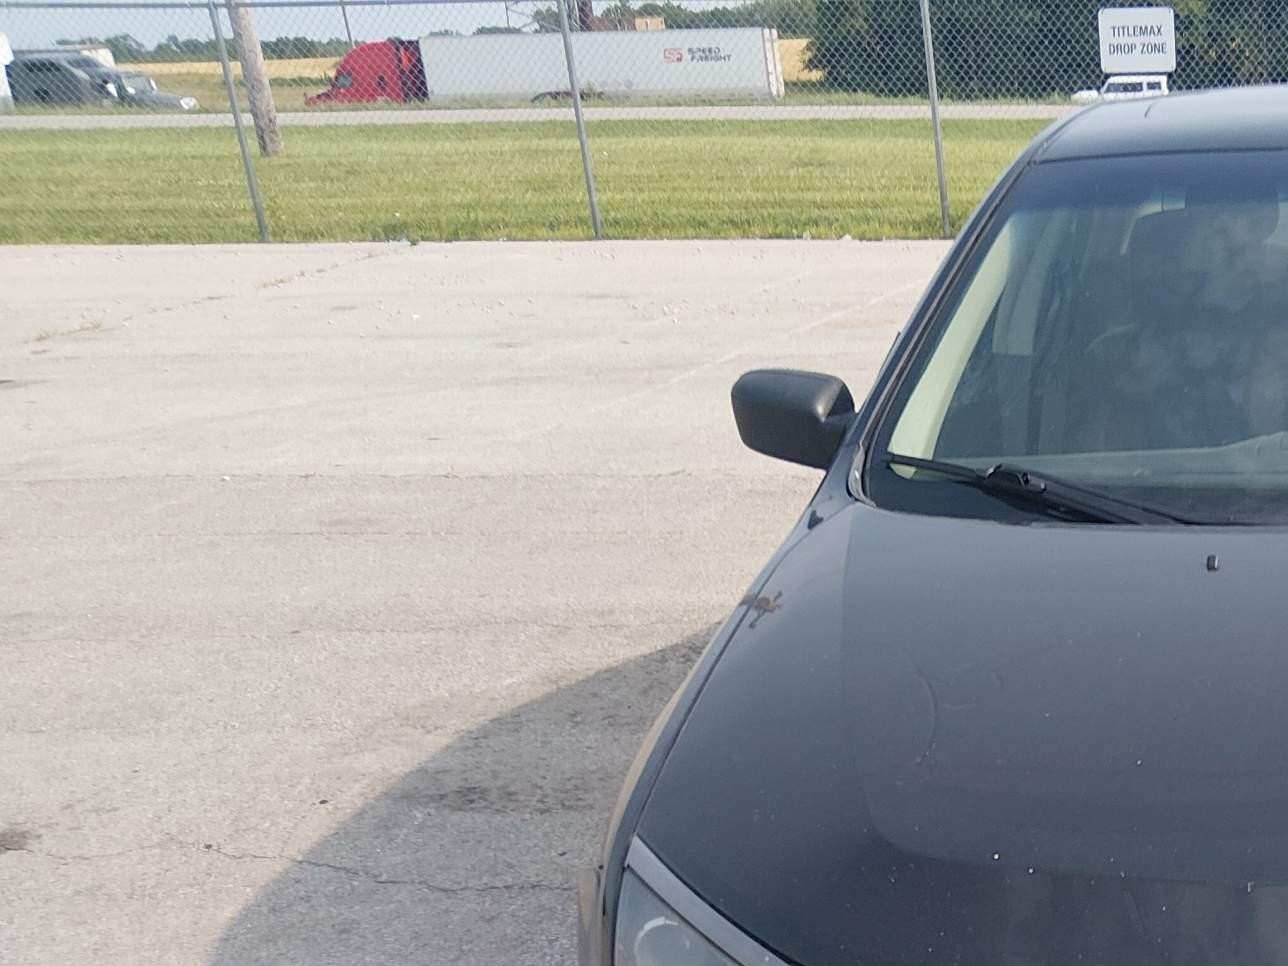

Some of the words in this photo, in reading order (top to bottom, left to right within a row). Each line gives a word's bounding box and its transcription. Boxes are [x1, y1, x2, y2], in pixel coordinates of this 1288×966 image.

[1110, 24, 1163, 38] TITLEMAX
[687, 47, 721, 55] SPEED
[1108, 43, 1137, 55] DROP
[1140, 42, 1168, 55] ZONE
[690, 54, 732, 63] FREIGHT
